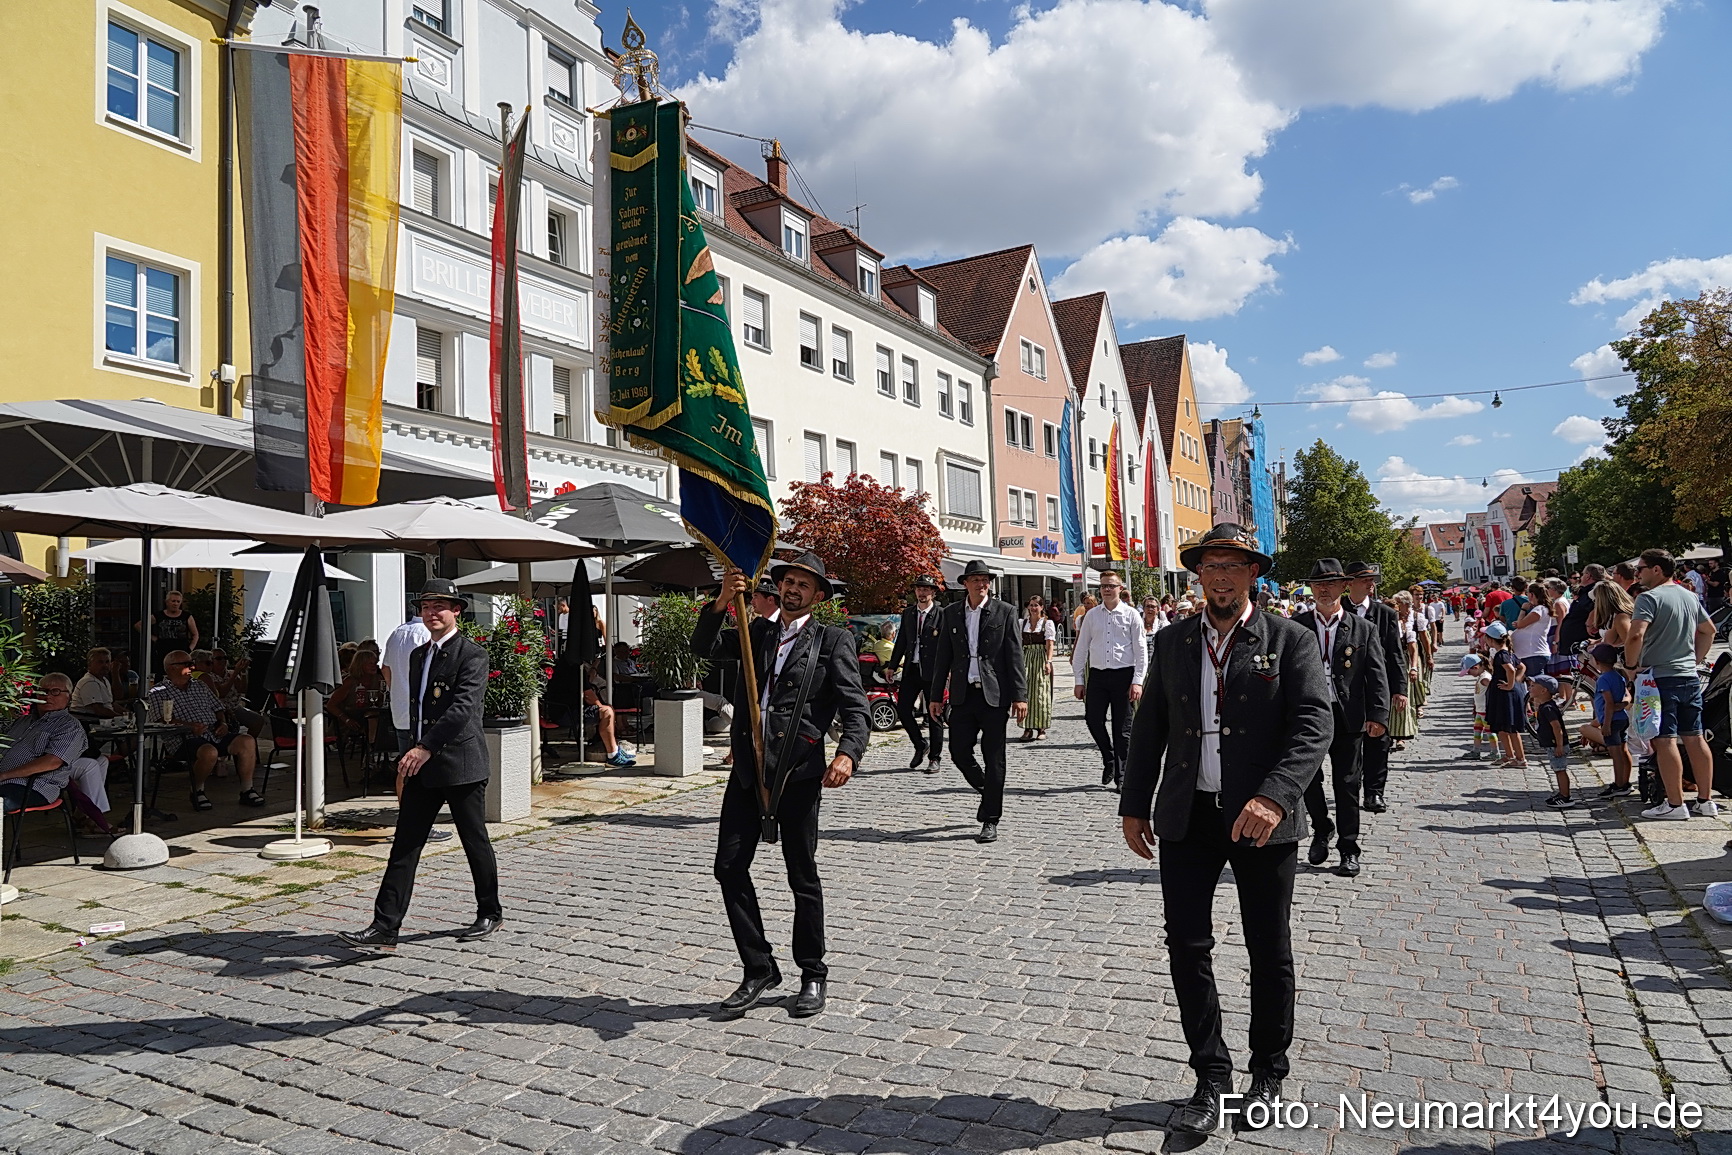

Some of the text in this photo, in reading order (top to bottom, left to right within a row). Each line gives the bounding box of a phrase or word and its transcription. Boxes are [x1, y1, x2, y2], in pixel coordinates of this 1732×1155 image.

[615, 233, 648, 252] gewidmet
[625, 253, 639, 264] vom
[422, 254, 489, 301] BRILLE
[615, 365, 640, 377] Berg
[631, 386, 648, 399] 1969
